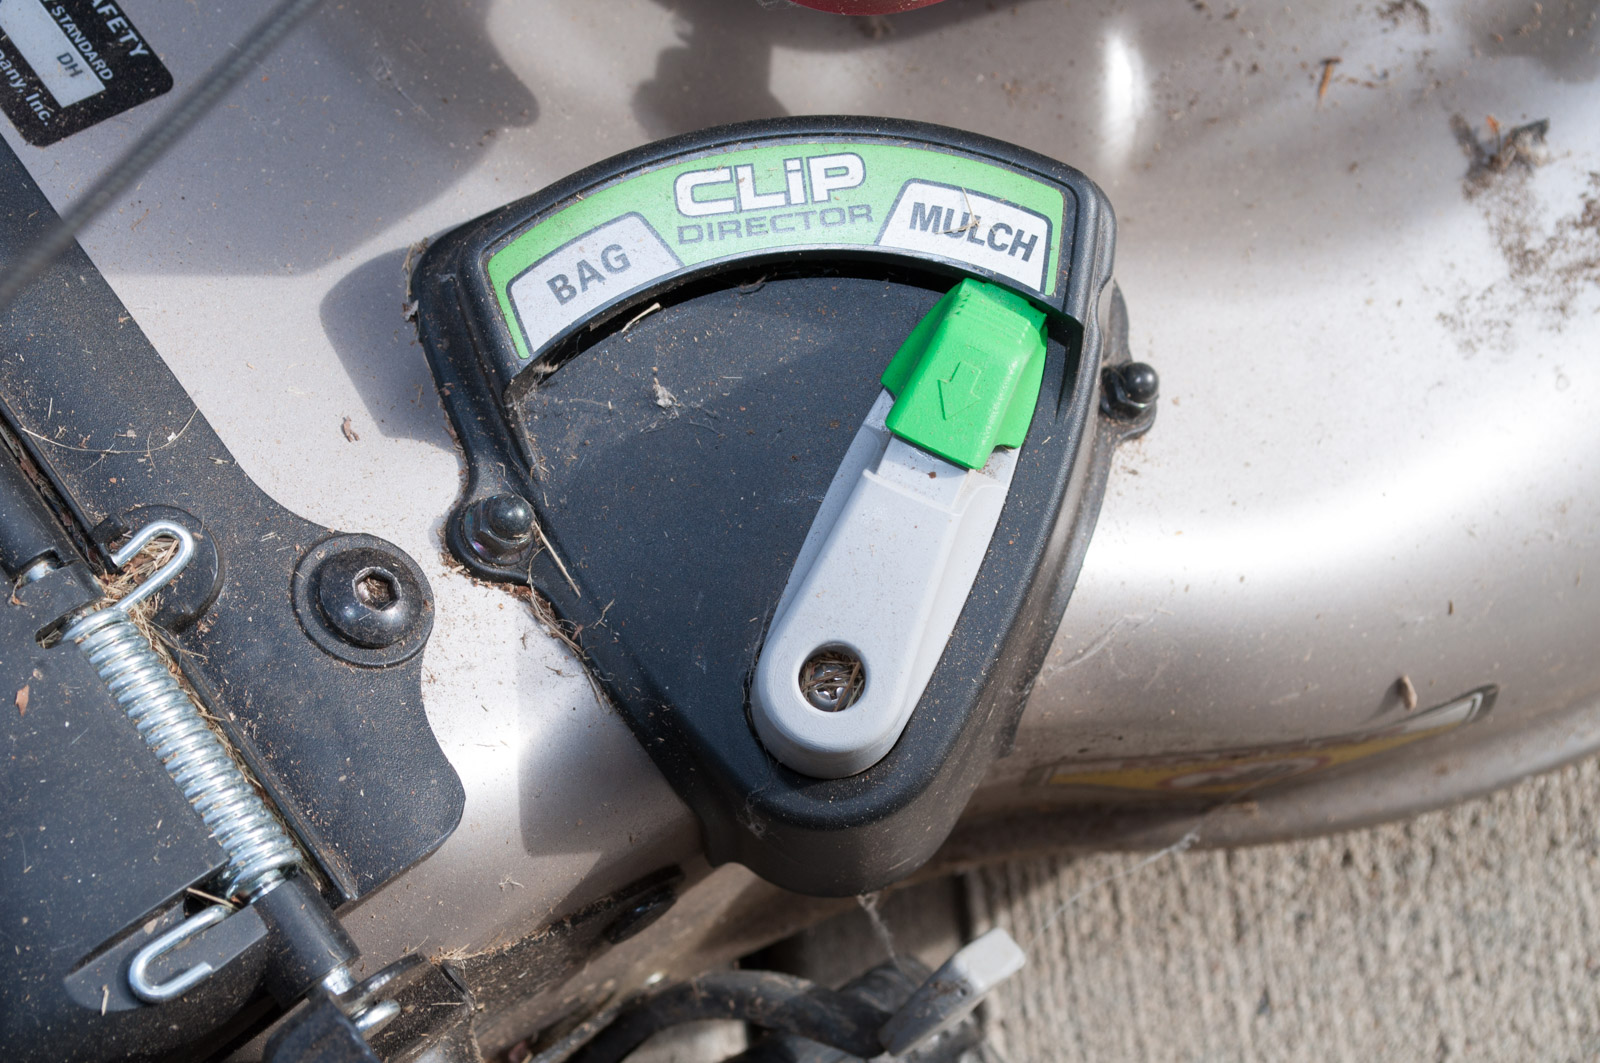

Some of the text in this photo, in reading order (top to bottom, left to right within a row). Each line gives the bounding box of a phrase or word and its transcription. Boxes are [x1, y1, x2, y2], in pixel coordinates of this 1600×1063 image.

[51, 5, 114, 81] STANDARD
[56, 52, 84, 78] DH
[25, 93, 51, 127] Inc.
[677, 204, 874, 245] DIRECTOR
[909, 202, 1039, 262] MULCH
[546, 244, 632, 306] BAG
